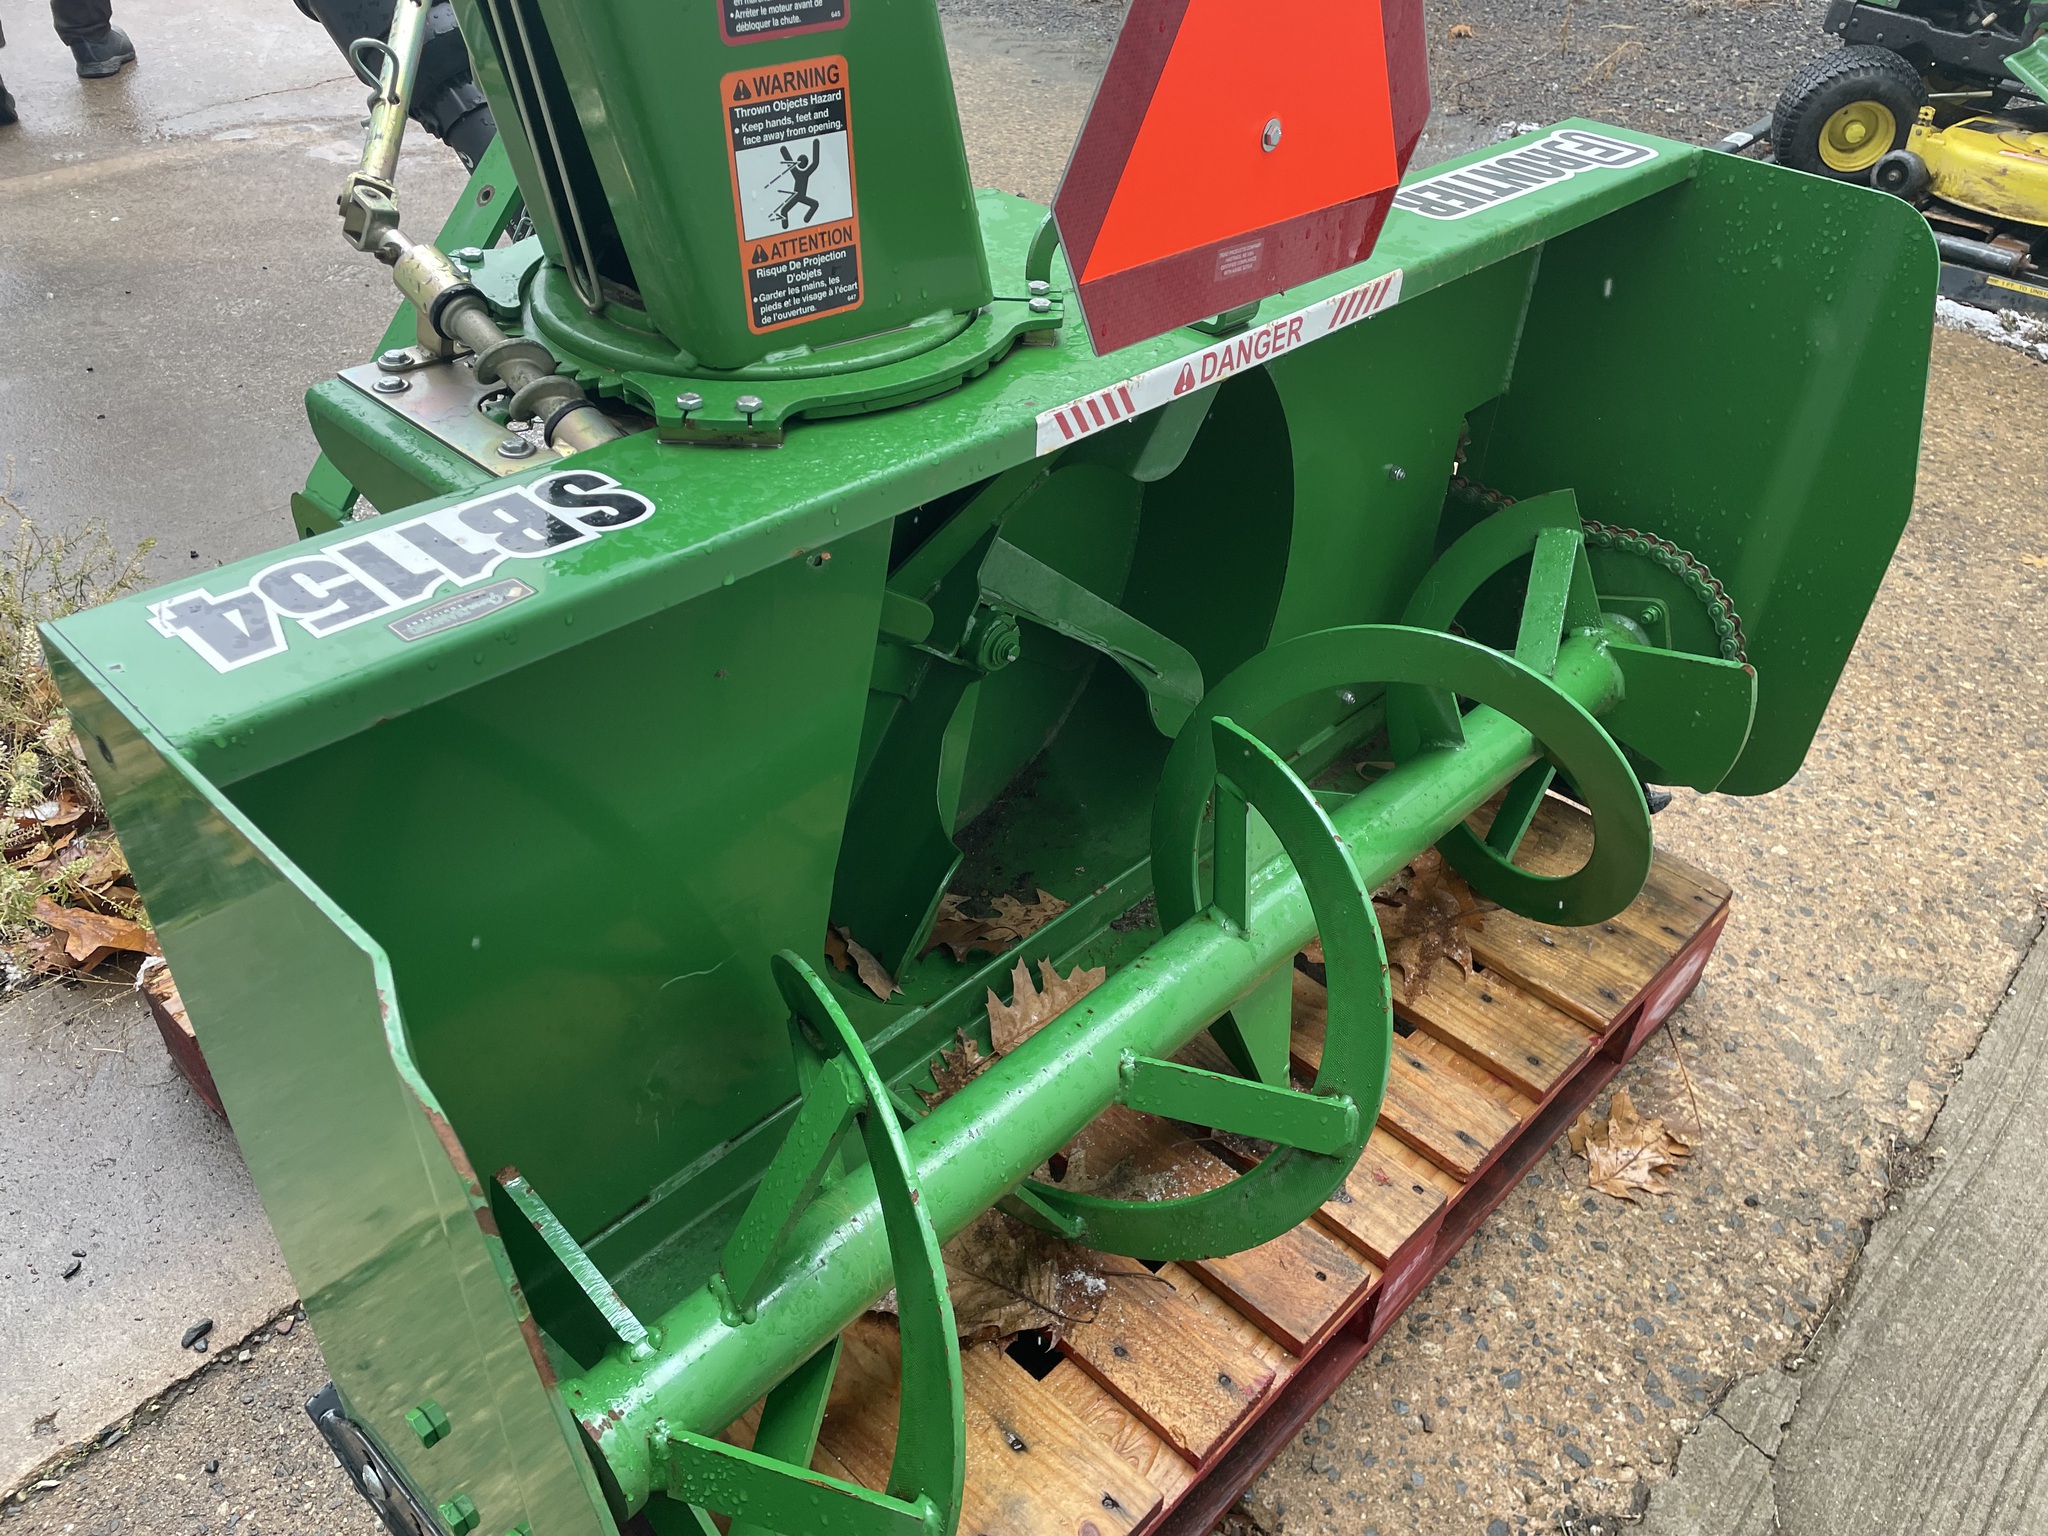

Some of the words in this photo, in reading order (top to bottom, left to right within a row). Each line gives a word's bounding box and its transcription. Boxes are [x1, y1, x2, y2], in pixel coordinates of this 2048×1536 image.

[735, 8, 759, 19] Arrêter
[760, 6, 767, 15] le
[768, 4, 793, 14] moteur
[794, 1, 813, 10] avant
[736, 19, 771, 32] débloquer
[772, 18, 779, 26] la
[780, 14, 802, 25] chute.
[753, 64, 840, 97] WARNING
[734, 105, 771, 118] Thrown
[773, 97, 808, 112] Objects
[810, 90, 842, 105] Hazard
[741, 122, 764, 133] Keep
[765, 116, 794, 128] hands,
[796, 112, 811, 123] feet
[814, 108, 829, 119] and
[742, 135, 761, 146] face
[763, 131, 785, 142] away
[786, 127, 806, 138] from
[808, 120, 843, 135] opening.
[1395, 131, 1651, 217] FRONTIER
[771, 225, 853, 260] ATTENTION
[756, 264, 788, 279] Risque
[789, 260, 801, 270] De
[803, 250, 847, 267] Projection
[786, 268, 822, 284] D'objets
[759, 290, 786, 302] Garder
[788, 286, 800, 295] les
[801, 280, 827, 292] mains,
[828, 276, 841, 285] les
[760, 301, 782, 315] pieds
[784, 299, 791, 308] et
[793, 296, 800, 305] le
[802, 290, 827, 303] visage
[828, 287, 834, 296] à
[835, 281, 858, 294] l'écart
[761, 315, 772, 325] de
[773, 304, 817, 321] l'ouverture.
[1200, 316, 1304, 384] DANGER
[148, 470, 656, 672] SB1154
